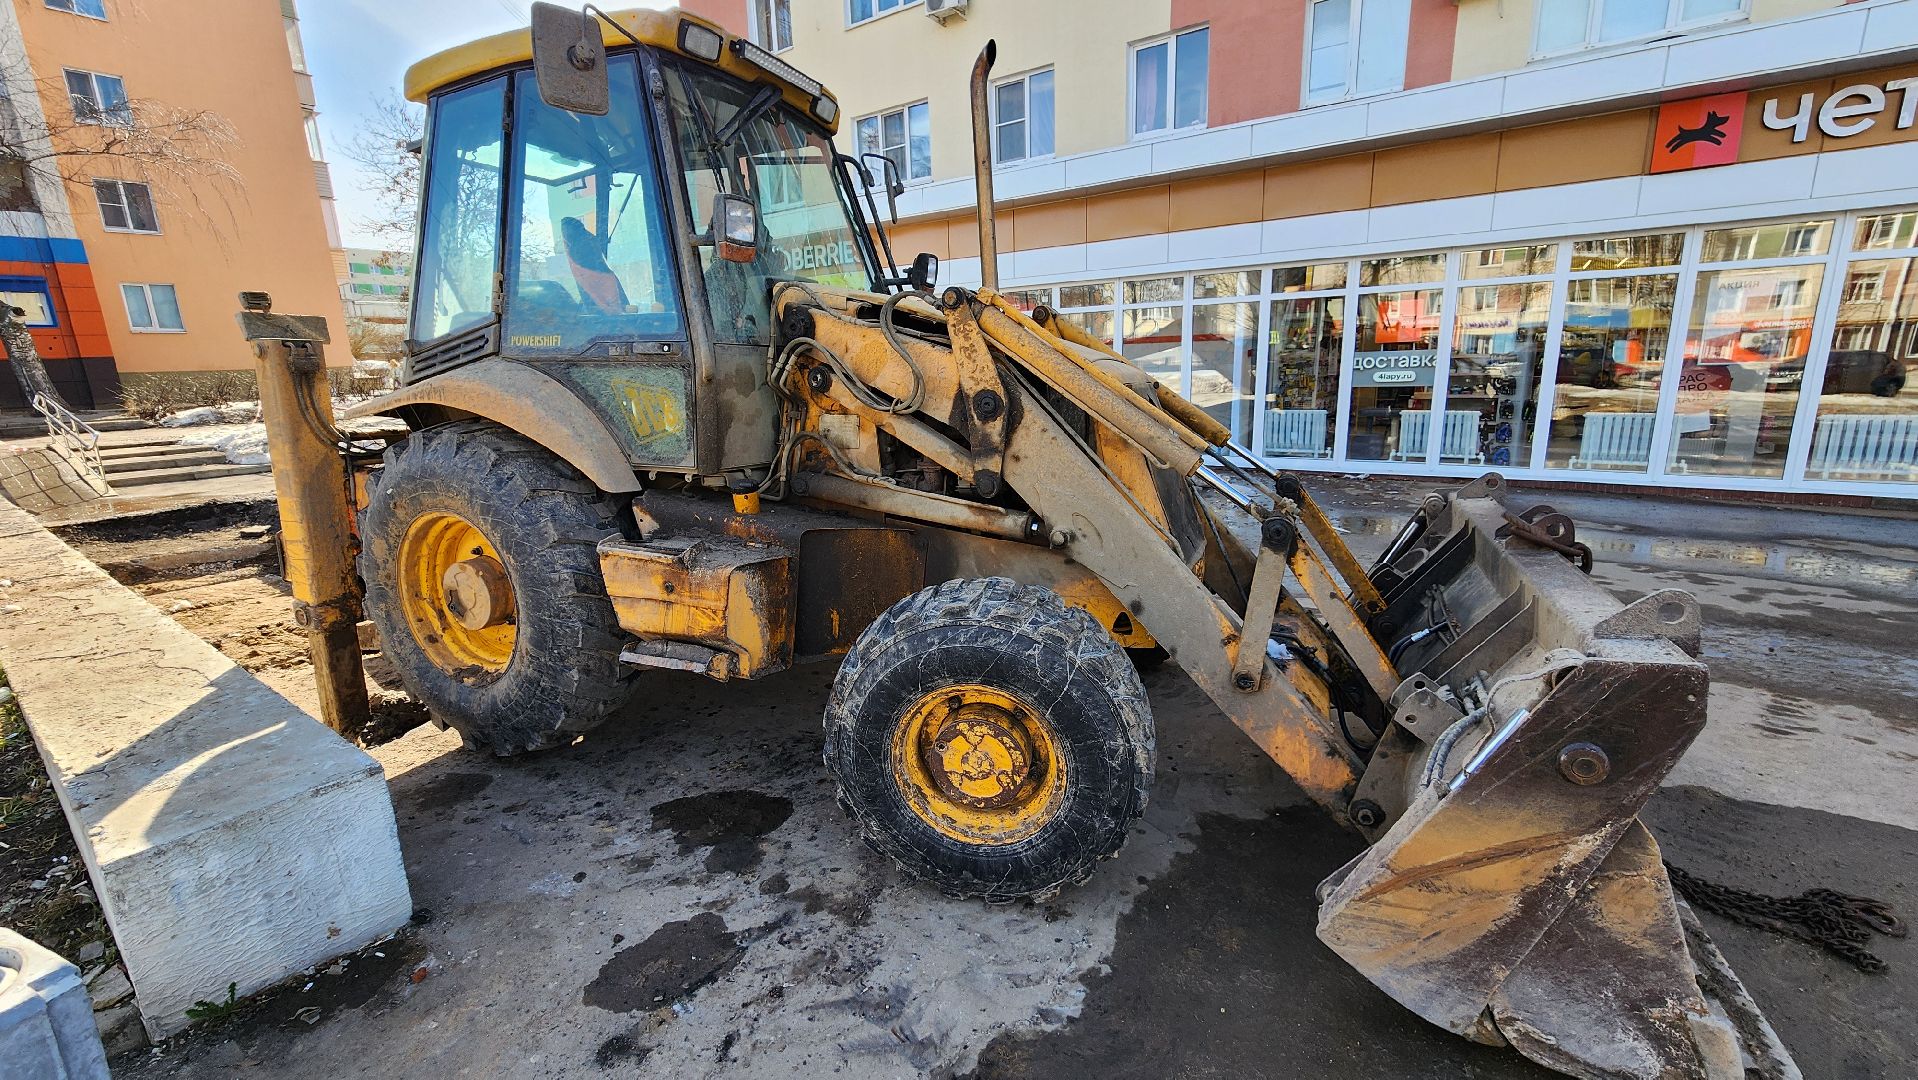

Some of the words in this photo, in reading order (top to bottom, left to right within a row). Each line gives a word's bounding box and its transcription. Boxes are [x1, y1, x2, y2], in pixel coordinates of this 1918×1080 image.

[782, 240, 860, 271] BERRIE
[1718, 280, 1760, 290] АКЦИЯ
[511, 335, 561, 347] POWERSHIFT
[1378, 373, 1412, 381] 4lapy.ru
[1679, 373, 1706, 384] РАС
[1677, 382, 1708, 392] ПРО
[622, 384, 682, 437] JCB
